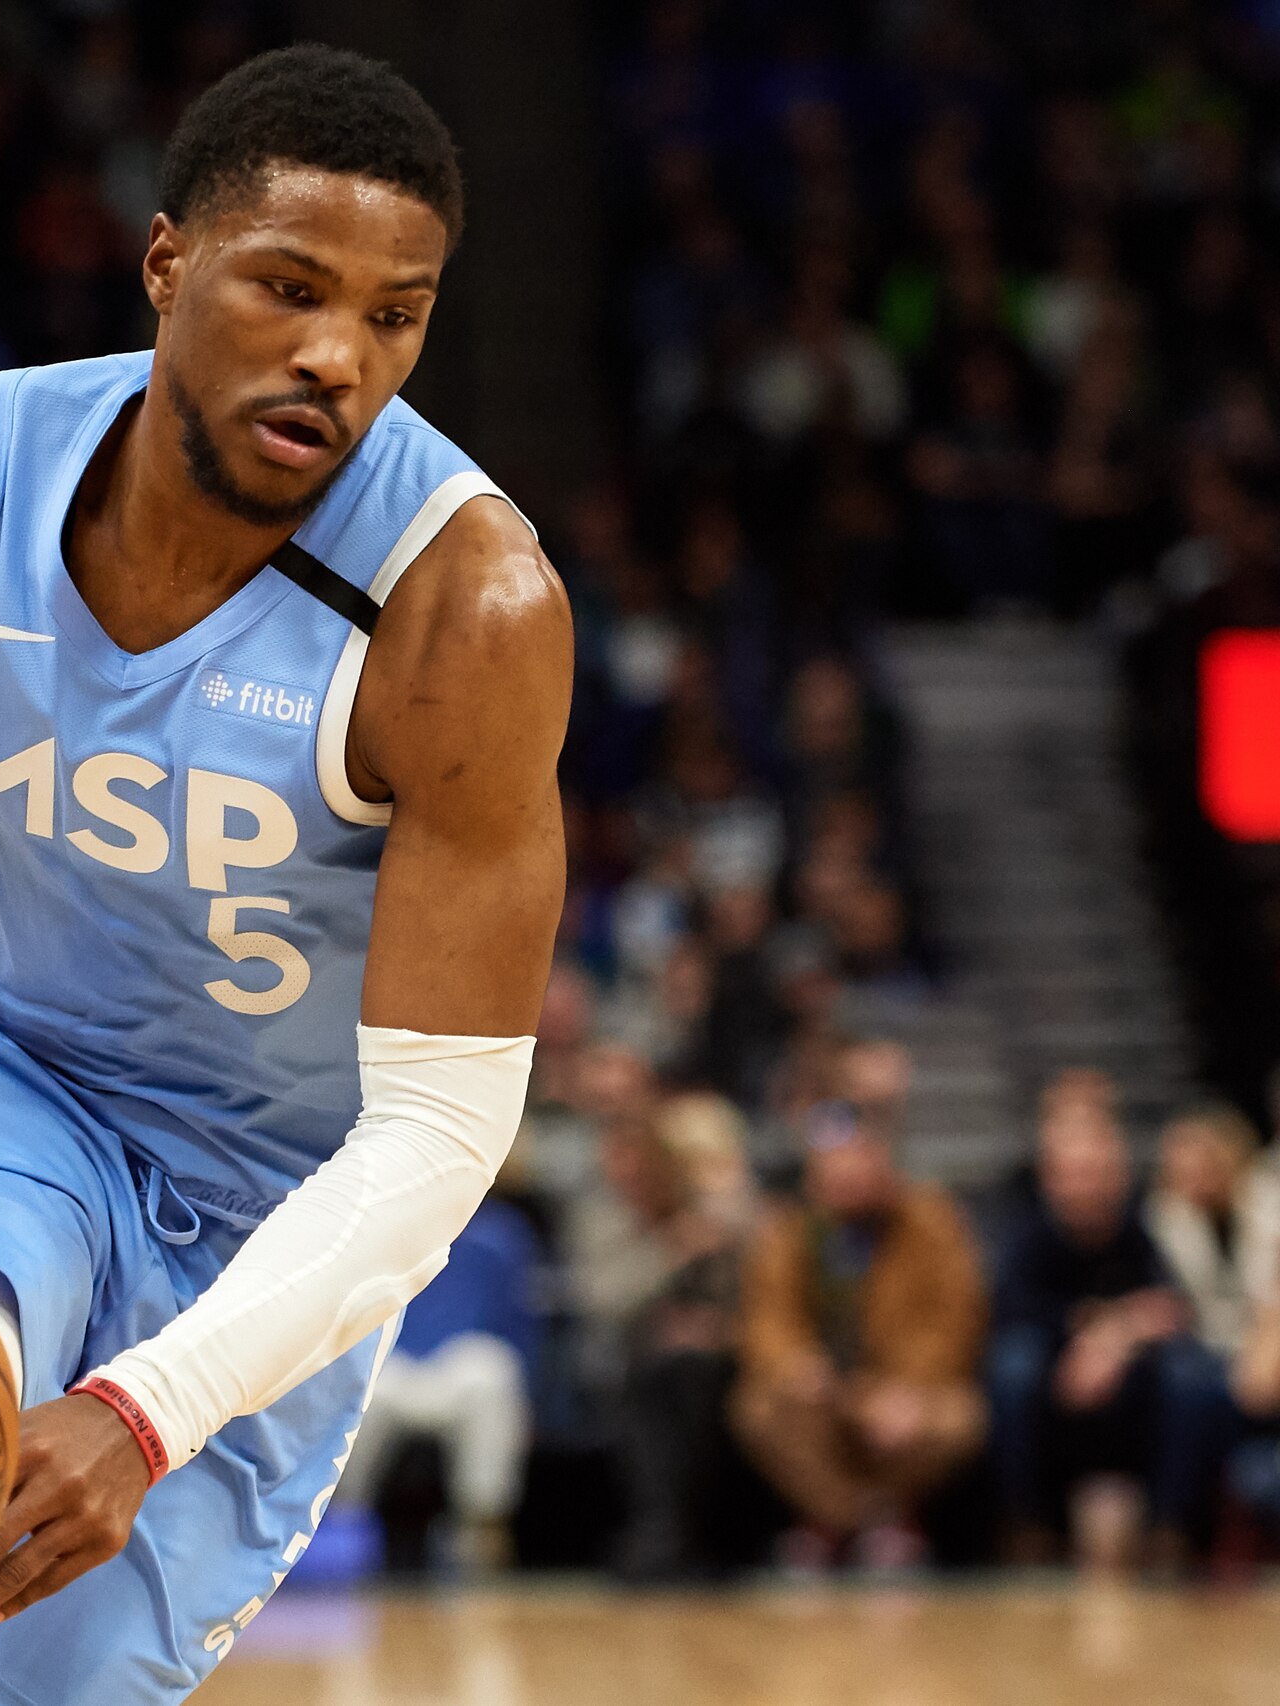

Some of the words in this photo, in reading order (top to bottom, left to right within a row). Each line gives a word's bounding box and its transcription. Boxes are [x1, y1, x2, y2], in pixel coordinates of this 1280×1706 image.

[239, 682, 314, 726] fitbit
[203, 896, 312, 1016] 5
[95, 1379, 149, 1433] Nothing
[145, 1434, 165, 1468] Fear
